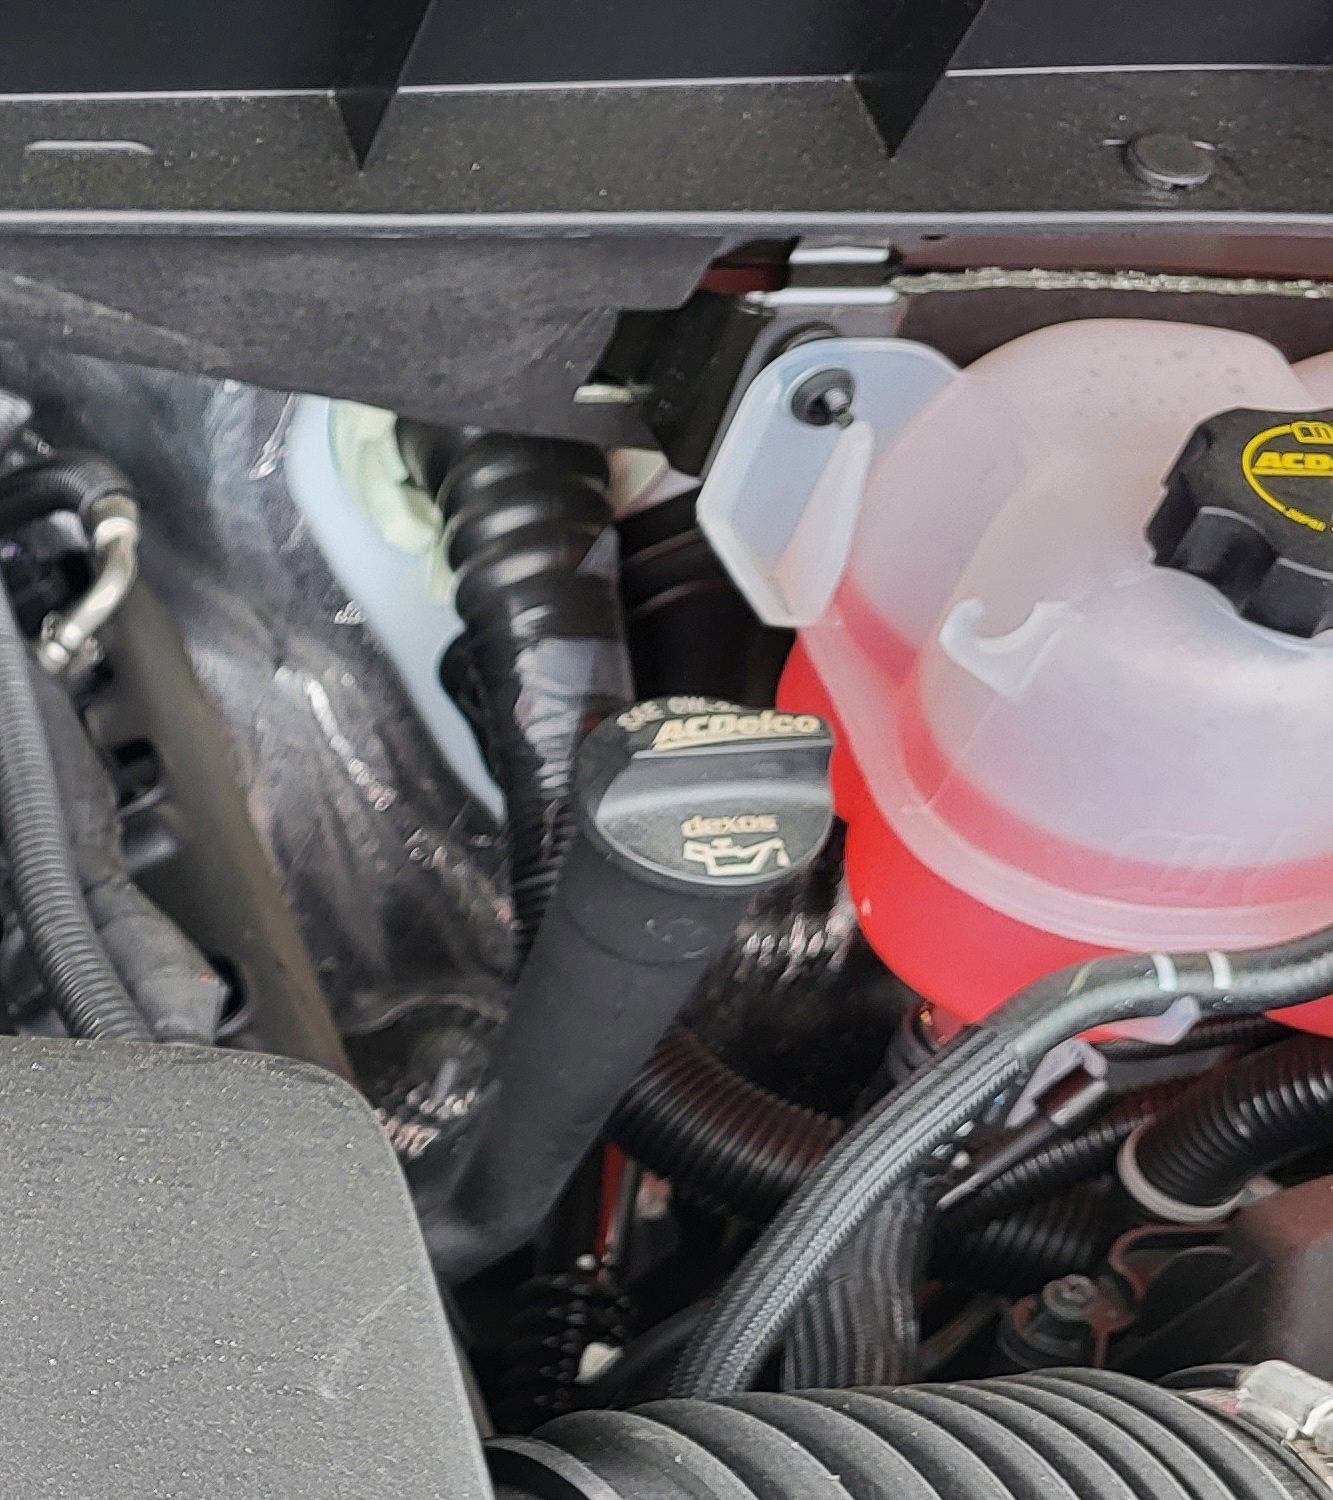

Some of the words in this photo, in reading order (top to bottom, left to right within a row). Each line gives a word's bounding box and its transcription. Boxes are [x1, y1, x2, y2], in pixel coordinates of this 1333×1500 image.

[1253, 452, 1333, 473] ACD
[652, 710, 820, 749] ACDelco
[681, 813, 779, 838] dexos
